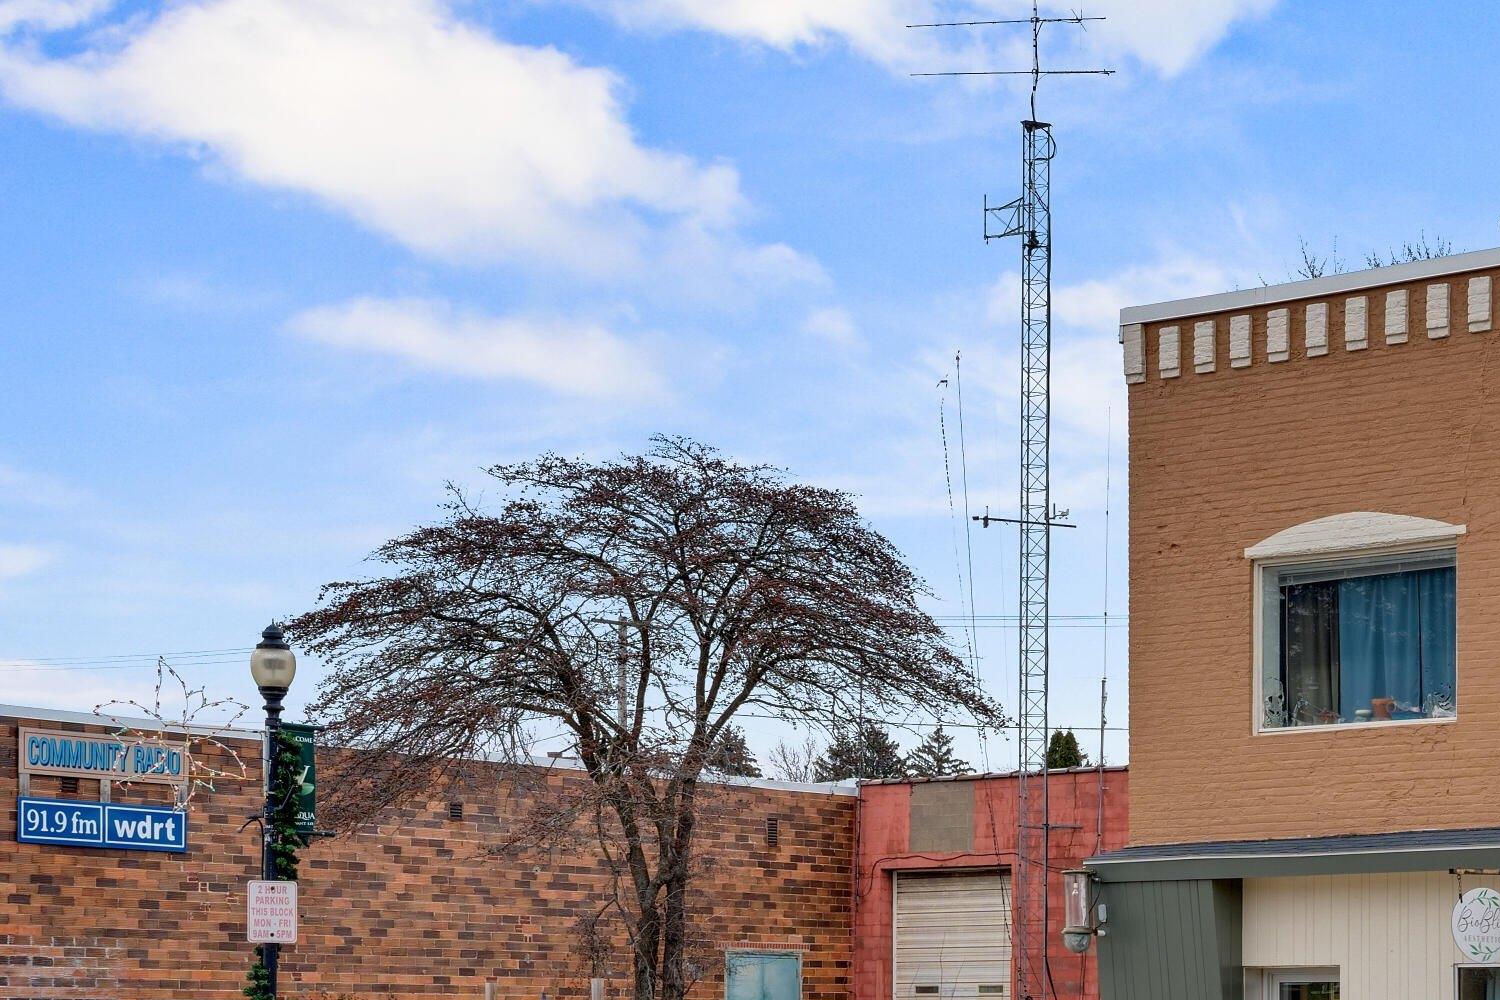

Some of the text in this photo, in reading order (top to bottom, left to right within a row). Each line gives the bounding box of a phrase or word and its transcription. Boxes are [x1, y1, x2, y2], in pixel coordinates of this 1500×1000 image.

[27, 736, 181, 776] COMMUNITY RADIO
[26, 808, 176, 841] 91.9 fm wdrt
[257, 885, 288, 895] 2 HOUR
[255, 896, 290, 905] PARKING
[251, 907, 294, 917] THIS BLOCK
[253, 918, 272, 928] MON
[278, 919, 291, 929] FRI
[252, 929, 292, 939] 9AM 5PM
